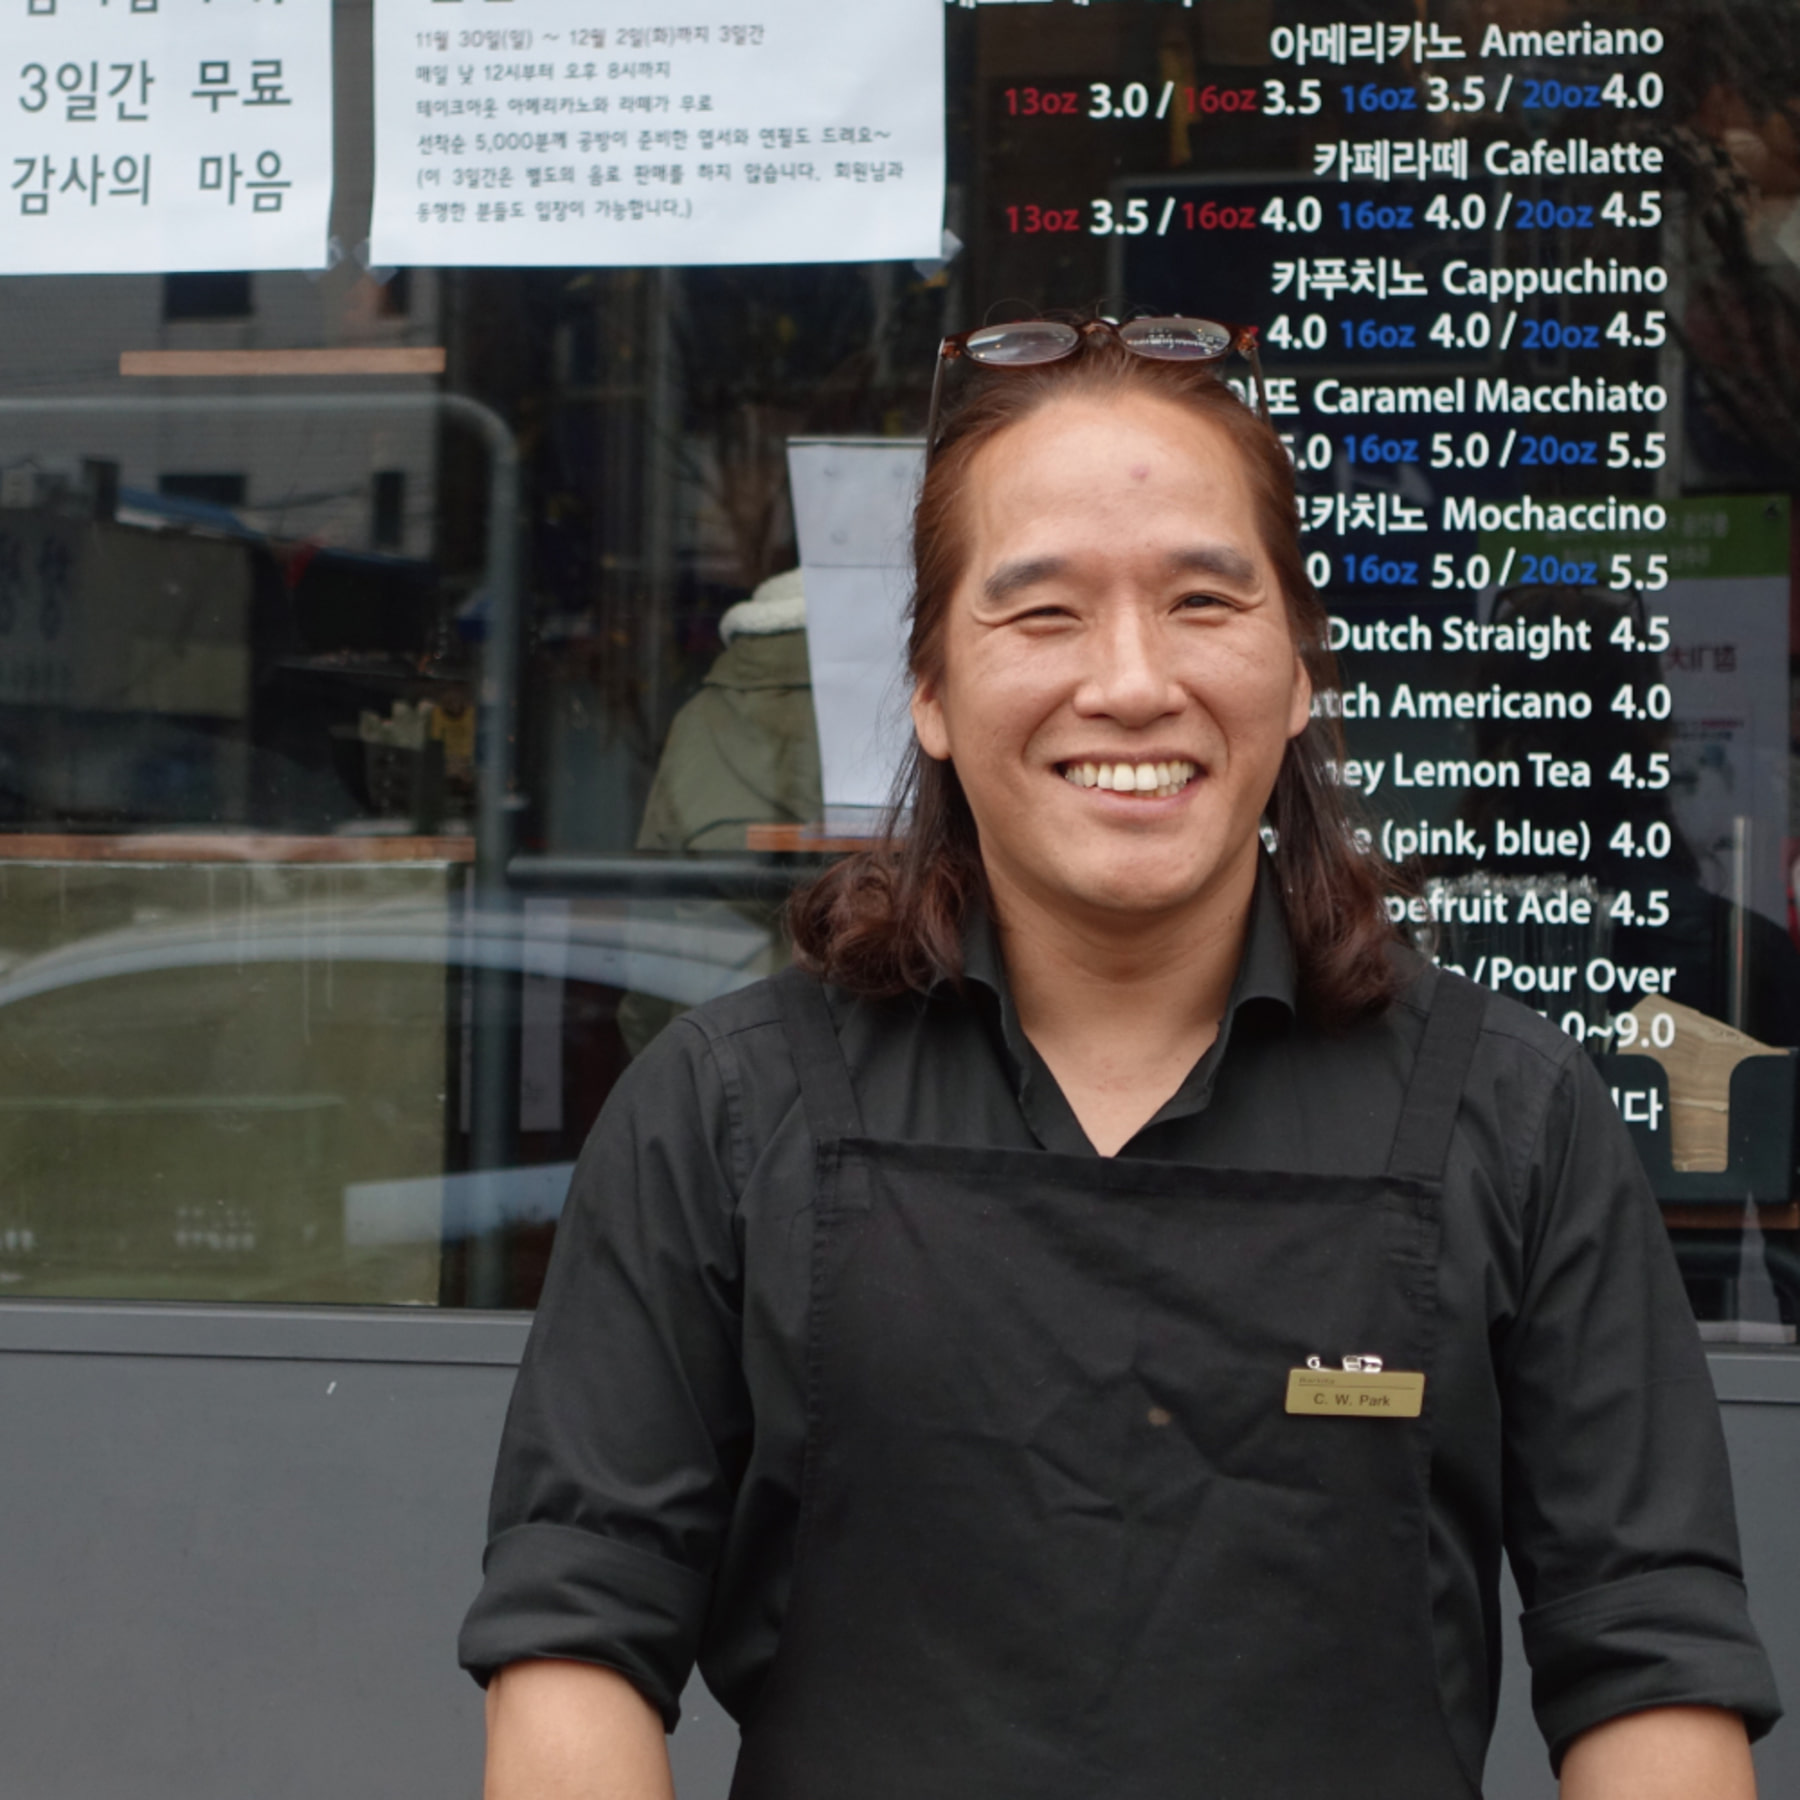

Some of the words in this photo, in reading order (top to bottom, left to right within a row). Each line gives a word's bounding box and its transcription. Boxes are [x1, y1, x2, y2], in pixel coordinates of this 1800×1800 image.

[570, 28, 605, 48] 12월
[720, 25, 764, 45] 3일간
[1271, 22, 1466, 65] 아메리카노
[1480, 22, 1663, 57] Ameriano
[18, 59, 156, 122] 3일간
[190, 59, 293, 113] 무료
[416, 65, 448, 85] 매일
[484, 64, 554, 81] 12시부터
[565, 62, 597, 80] 오후
[608, 62, 670, 79] 8시까지
[1006, 88, 1077, 115] 13oz
[1089, 83, 1147, 118] 3.0
[1184, 86, 1256, 114] 16oz
[1263, 80, 1321, 114] 3.5
[1342, 83, 1417, 113] 16oz
[1427, 76, 1485, 112] 3.5
[1522, 80, 1600, 108] 20oz
[1602, 73, 1663, 108] 4.0
[1314, 138, 1467, 181] 카페라떼
[1485, 139, 1663, 175] Cafellatte
[11, 153, 151, 216] 감사의
[198, 149, 293, 213] 마음
[1007, 205, 1079, 232] 13oz
[1091, 200, 1148, 234] 3.5
[1183, 202, 1255, 229] 16oz
[1261, 197, 1321, 231] 4.0
[1339, 201, 1413, 229] 16oz
[1425, 194, 1485, 229] 4.0
[1516, 200, 1593, 228] 20oz
[1601, 191, 1661, 226] 4.5
[1273, 257, 1427, 300] 카푸치노
[1443, 259, 1667, 302] Cappuchino
[1268, 315, 1326, 349] 4.0
[1341, 320, 1416, 348] 16oz
[1430, 313, 1490, 347] 4.0
[1522, 319, 1599, 348] 20oz
[1606, 312, 1666, 346] 4.5
[1314, 378, 1464, 413] Caramel
[1476, 377, 1667, 412] Macchiato
[1344, 434, 1419, 464] 16oz
[1431, 433, 1489, 467] 5.0
[1520, 436, 1597, 465] 20oz
[1607, 433, 1666, 468] 5.5
[1444, 495, 1666, 530] Mochaccino
[1343, 554, 1418, 584] 16oz
[1432, 554, 1490, 589] 5.0
[1520, 555, 1597, 585] 20oz
[1610, 555, 1668, 590] 5.5
[1325, 615, 1432, 651] Dutch
[1443, 616, 1591, 659] Straight
[1610, 617, 1670, 651] 4.5
[1391, 684, 1591, 718] Americano
[1611, 684, 1671, 719] 4.0
[1395, 753, 1519, 786] Lemon
[1528, 753, 1590, 787] Tea
[1610, 754, 1669, 788] 4.5
[1382, 820, 1485, 862] (pink,
[1497, 820, 1590, 860] blue)
[1610, 822, 1671, 857] 4.0
[1517, 889, 1593, 927] Ade
[1609, 891, 1669, 926] 4.5
[1586, 958, 1676, 996] Over
[1313, 1393, 1328, 1405] C.
[1335, 1394, 1353, 1406] W.
[1359, 1394, 1391, 1407] Park
